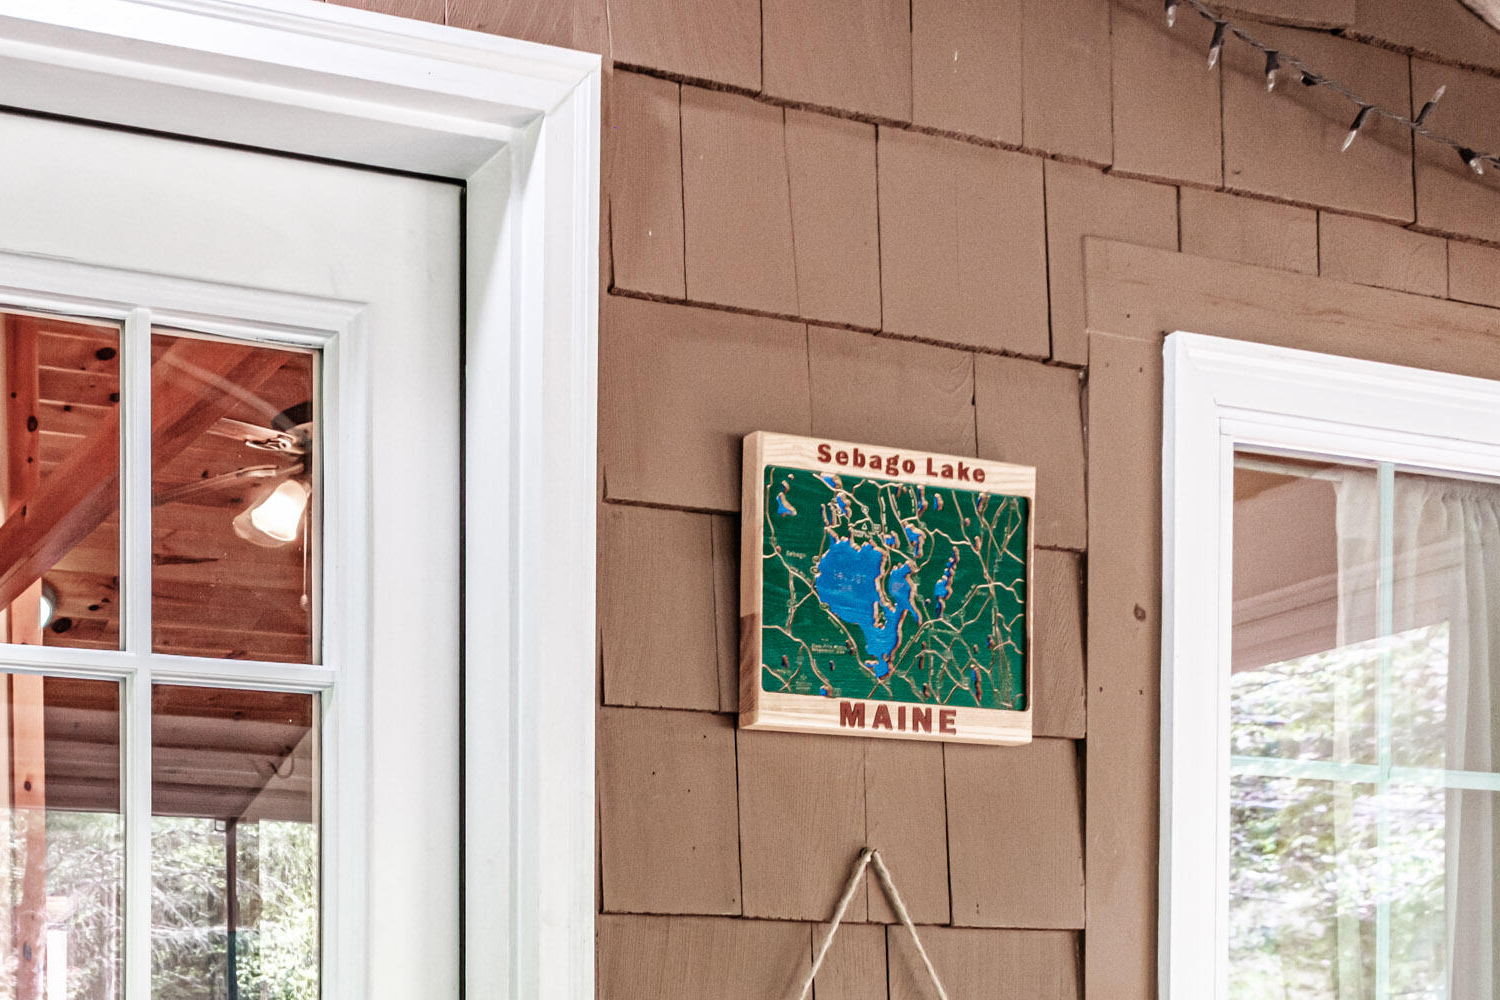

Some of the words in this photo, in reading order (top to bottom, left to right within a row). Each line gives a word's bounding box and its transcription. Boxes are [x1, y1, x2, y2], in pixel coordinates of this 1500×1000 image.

[816, 443, 916, 477] Sebago
[926, 457, 986, 483] Lake
[839, 701, 957, 735] MAINE
